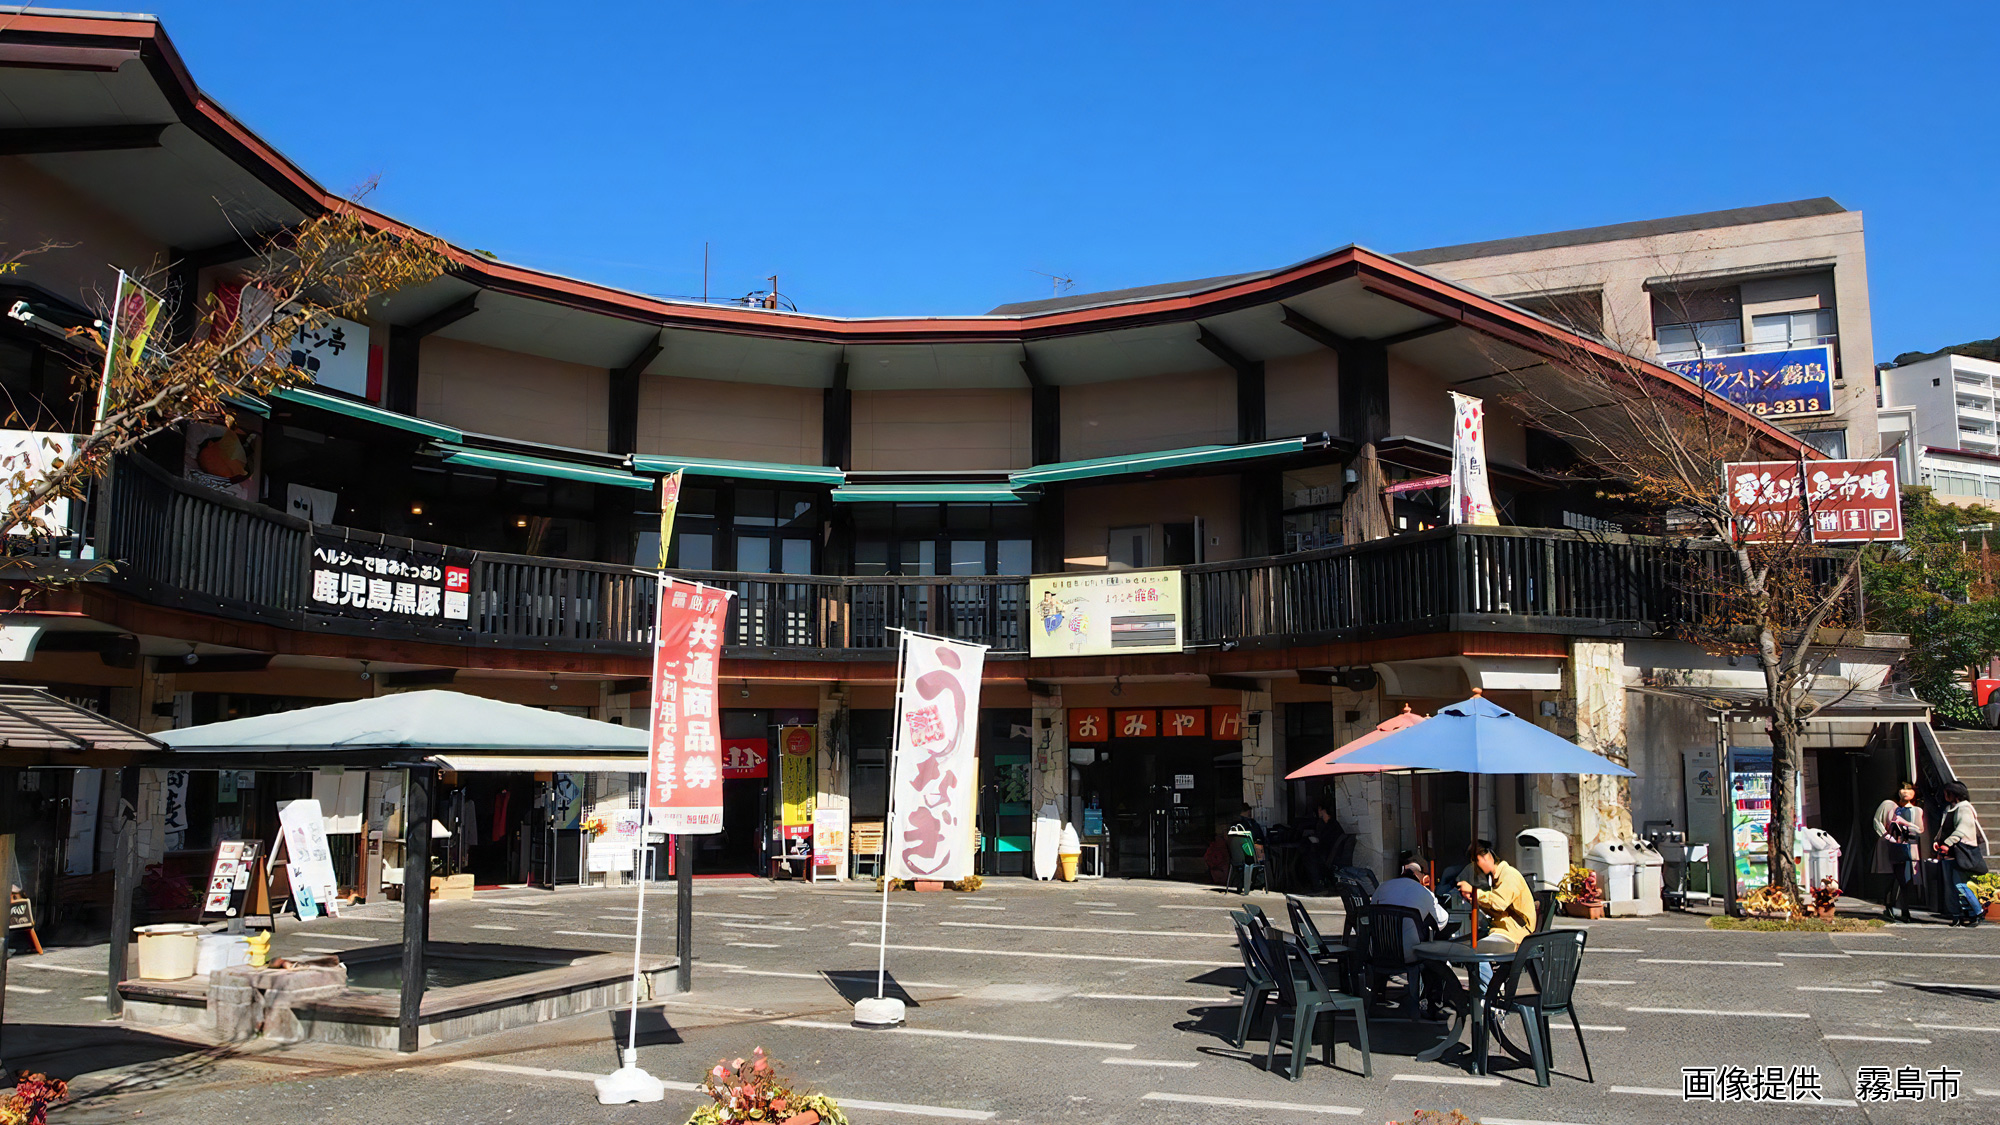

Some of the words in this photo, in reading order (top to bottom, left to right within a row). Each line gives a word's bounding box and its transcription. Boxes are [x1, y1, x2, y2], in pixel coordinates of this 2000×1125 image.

[1873, 510, 1890, 529] P
[314, 547, 442, 581] ヘルシーで旨みたっぷり
[447, 571, 468, 587] 2F
[312, 569, 442, 616] 鹿児島黒豚
[682, 616, 718, 789] 共通商品券
[656, 660, 680, 803] ご利用できます
[902, 646, 967, 876] うなぎ
